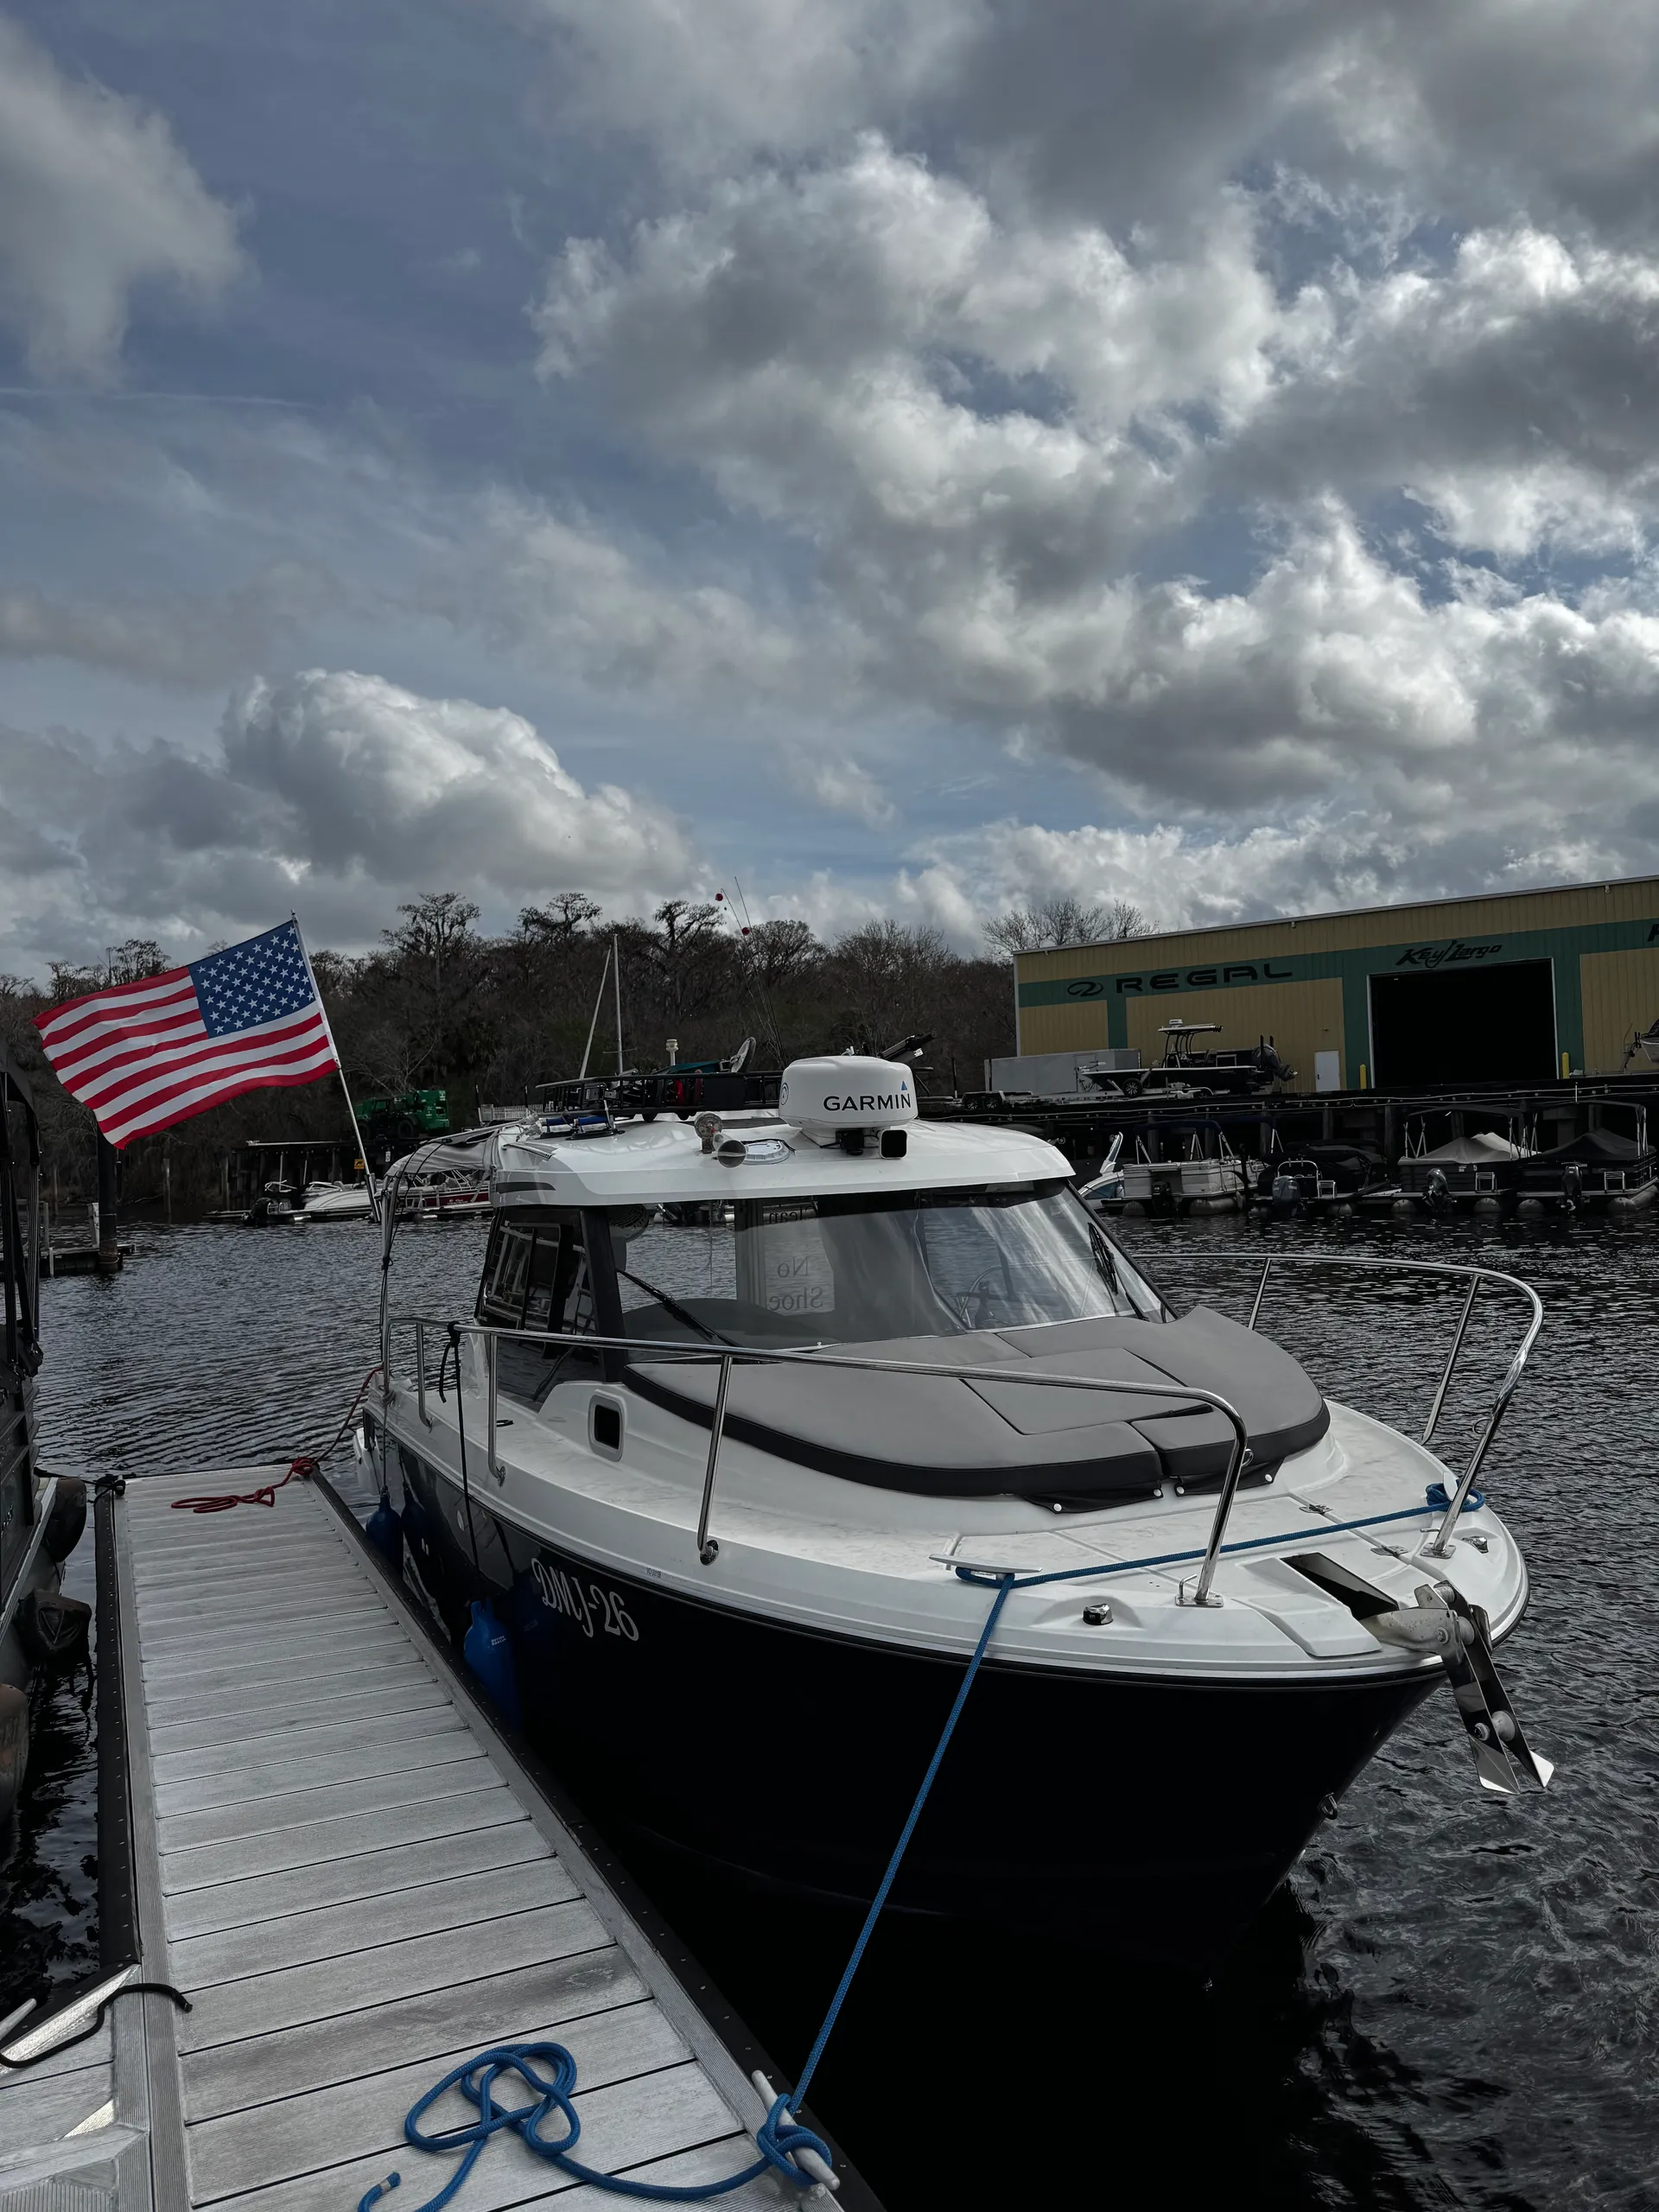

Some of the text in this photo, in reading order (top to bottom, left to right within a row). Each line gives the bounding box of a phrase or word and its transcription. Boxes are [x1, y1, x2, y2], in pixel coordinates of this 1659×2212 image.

[1395, 939, 1503, 969] Key Largo
[1116, 963, 1293, 994] REGAL
[823, 1093, 912, 1111] GARMIN
[531, 1557, 639, 1642] DMJ-26
